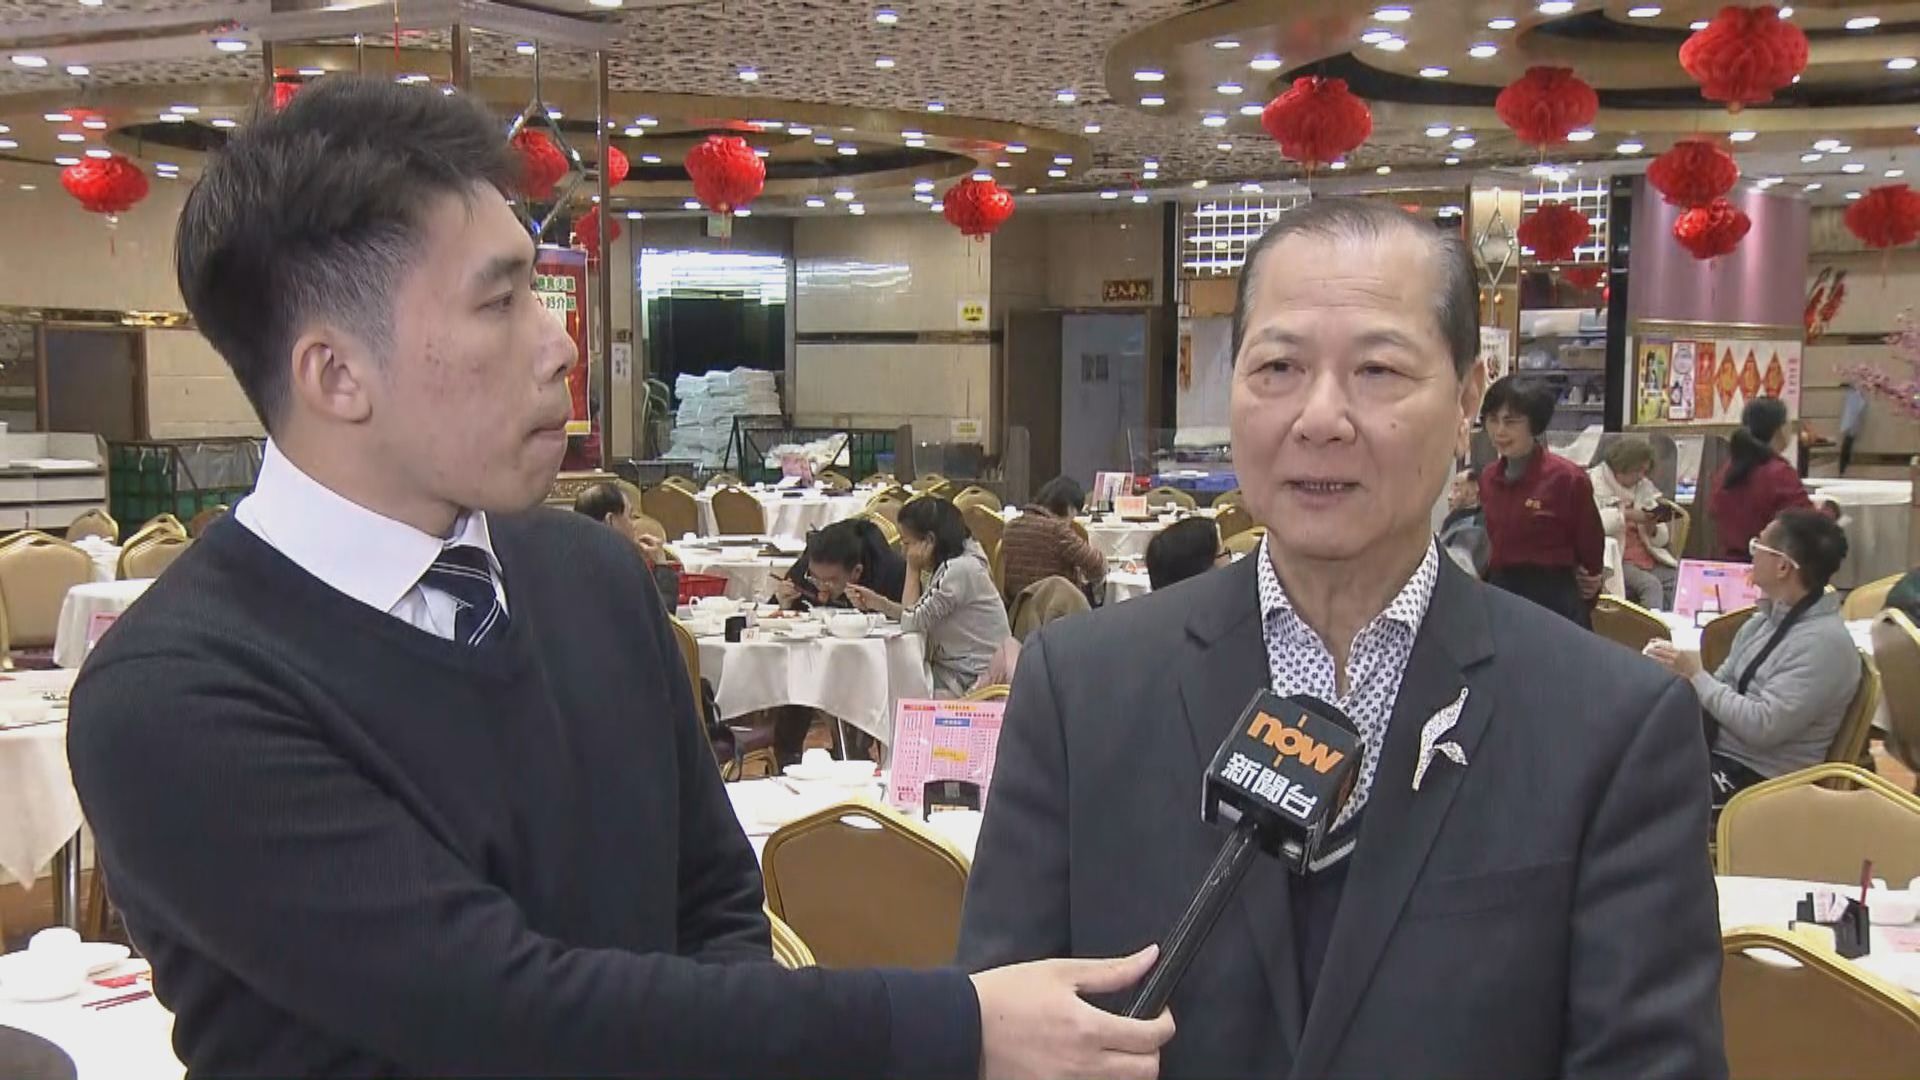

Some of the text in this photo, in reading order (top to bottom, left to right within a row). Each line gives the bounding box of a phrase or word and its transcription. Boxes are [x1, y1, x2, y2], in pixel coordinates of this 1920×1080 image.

[1247, 711, 1344, 773] now
[1220, 752, 1318, 819] 新聞台
